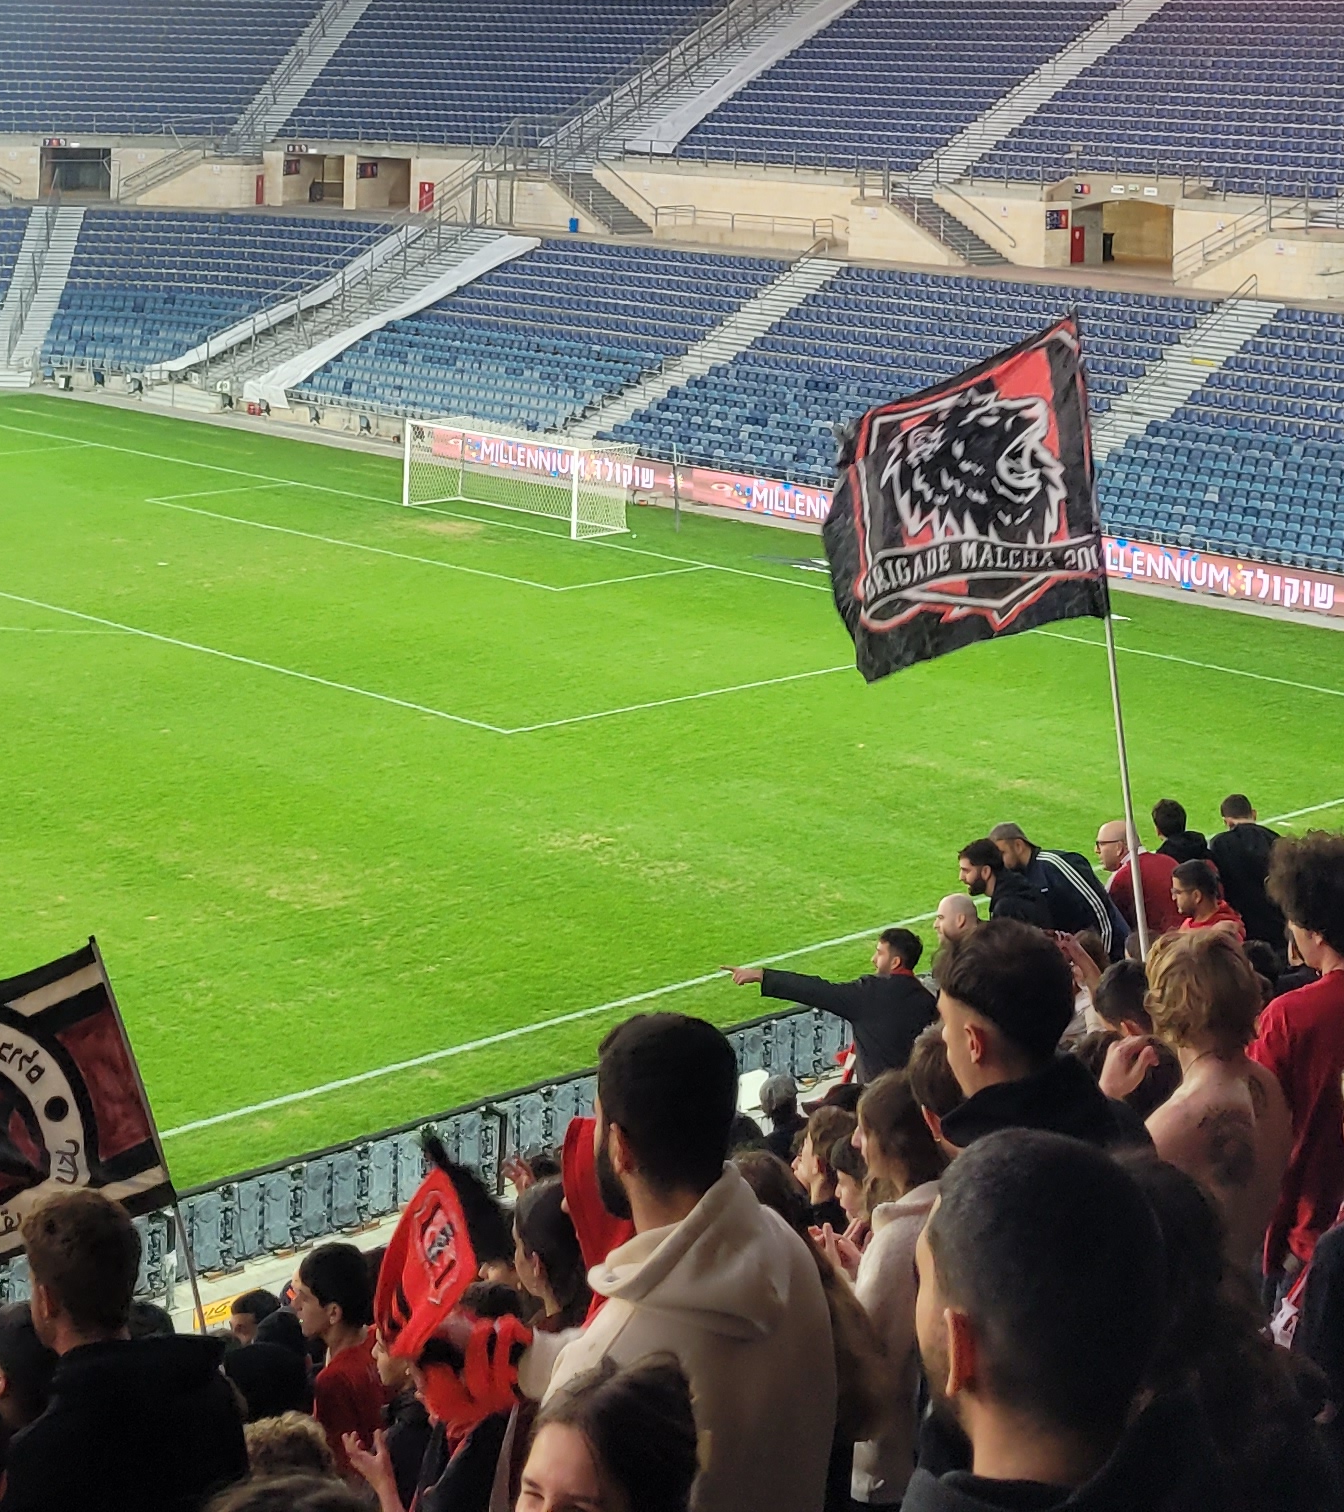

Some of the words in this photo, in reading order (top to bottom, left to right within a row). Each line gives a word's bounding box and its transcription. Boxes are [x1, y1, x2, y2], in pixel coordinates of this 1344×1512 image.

[480, 437, 586, 478] MILLENNIUM
[593, 457, 655, 489] שוקולד
[752, 484, 831, 519] MILLENN
[865, 544, 952, 601] BRIGADE
[960, 541, 1055, 570] MALCHA
[1063, 545, 1099, 571] 201
[1106, 543, 1230, 592] LLENNIUM
[1241, 568, 1335, 610] שוקולד
